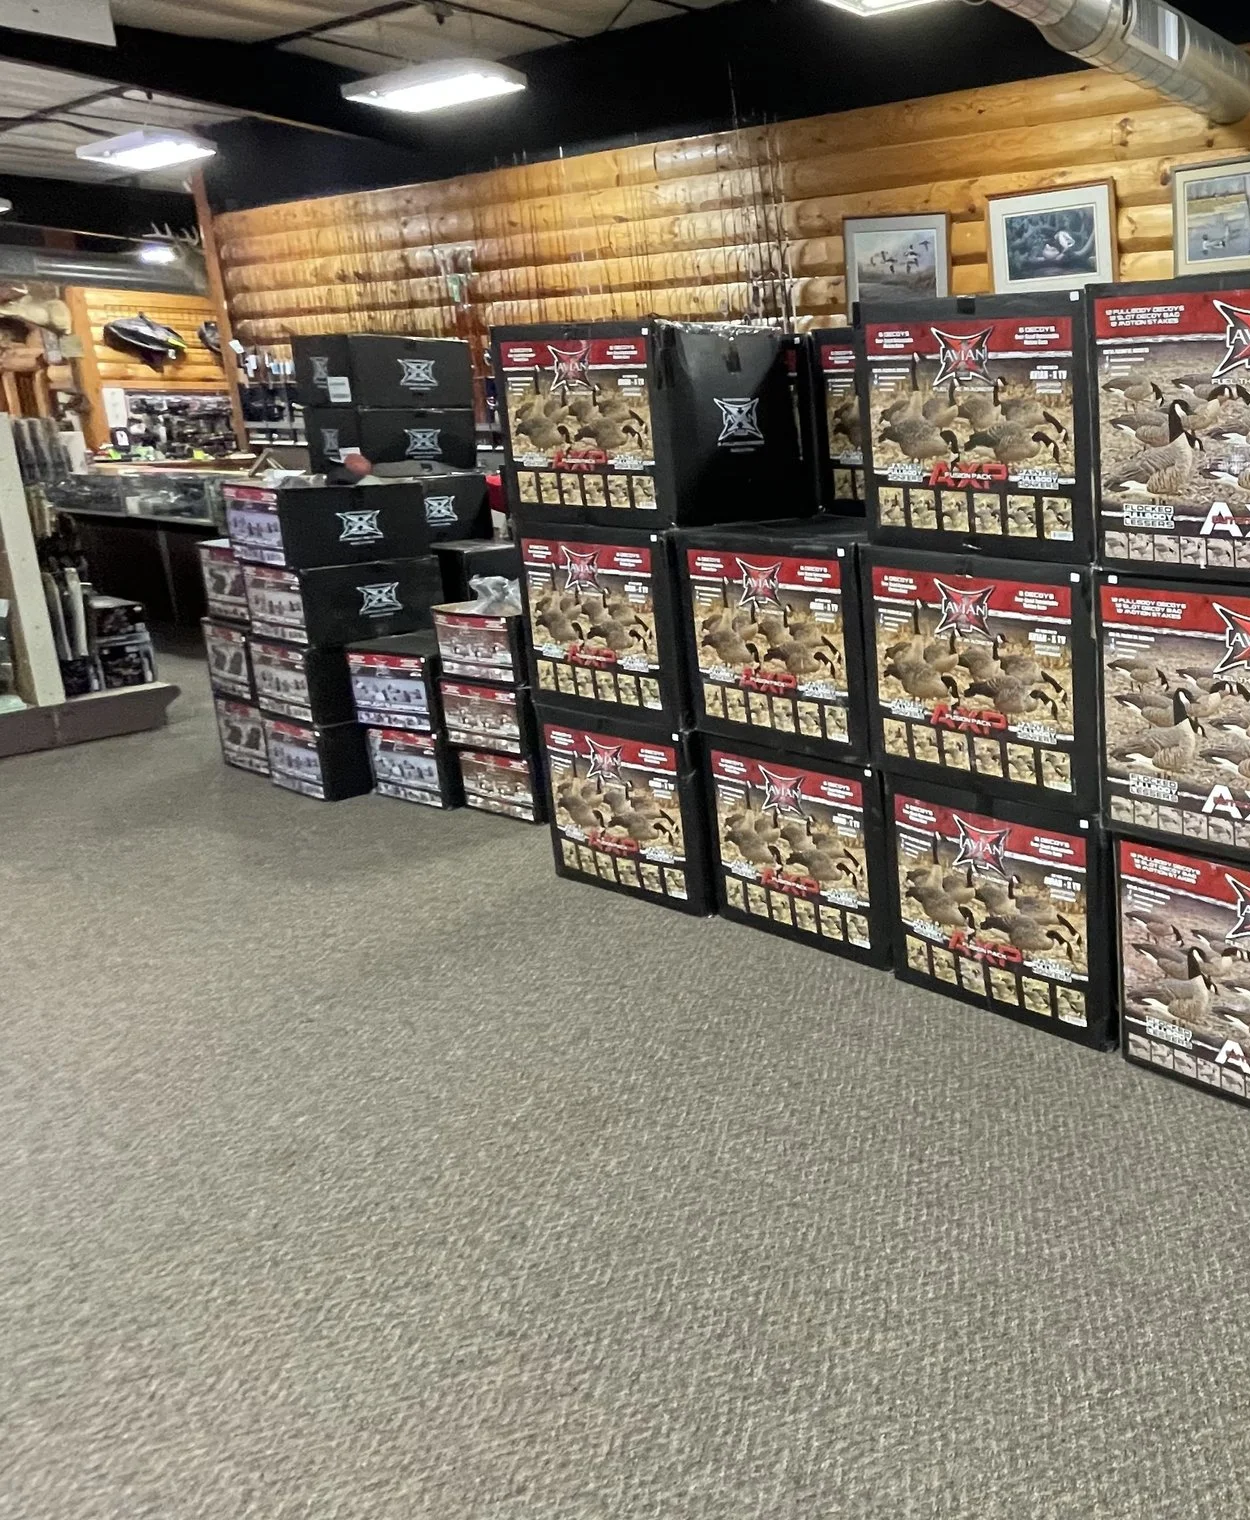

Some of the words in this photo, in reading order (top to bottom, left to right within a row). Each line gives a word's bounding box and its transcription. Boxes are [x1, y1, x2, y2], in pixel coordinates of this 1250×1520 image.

[944, 349, 985, 361] AVIAN
[929, 461, 1009, 489] AXP
[1125, 505, 1173, 514] FLOCKED
[1125, 520, 1173, 528] LESSERS
[946, 602, 987, 616] AVIAN
[930, 704, 1008, 735] AXP
[972, 718, 992, 727] PACK
[963, 838, 1001, 855] AVIAN
